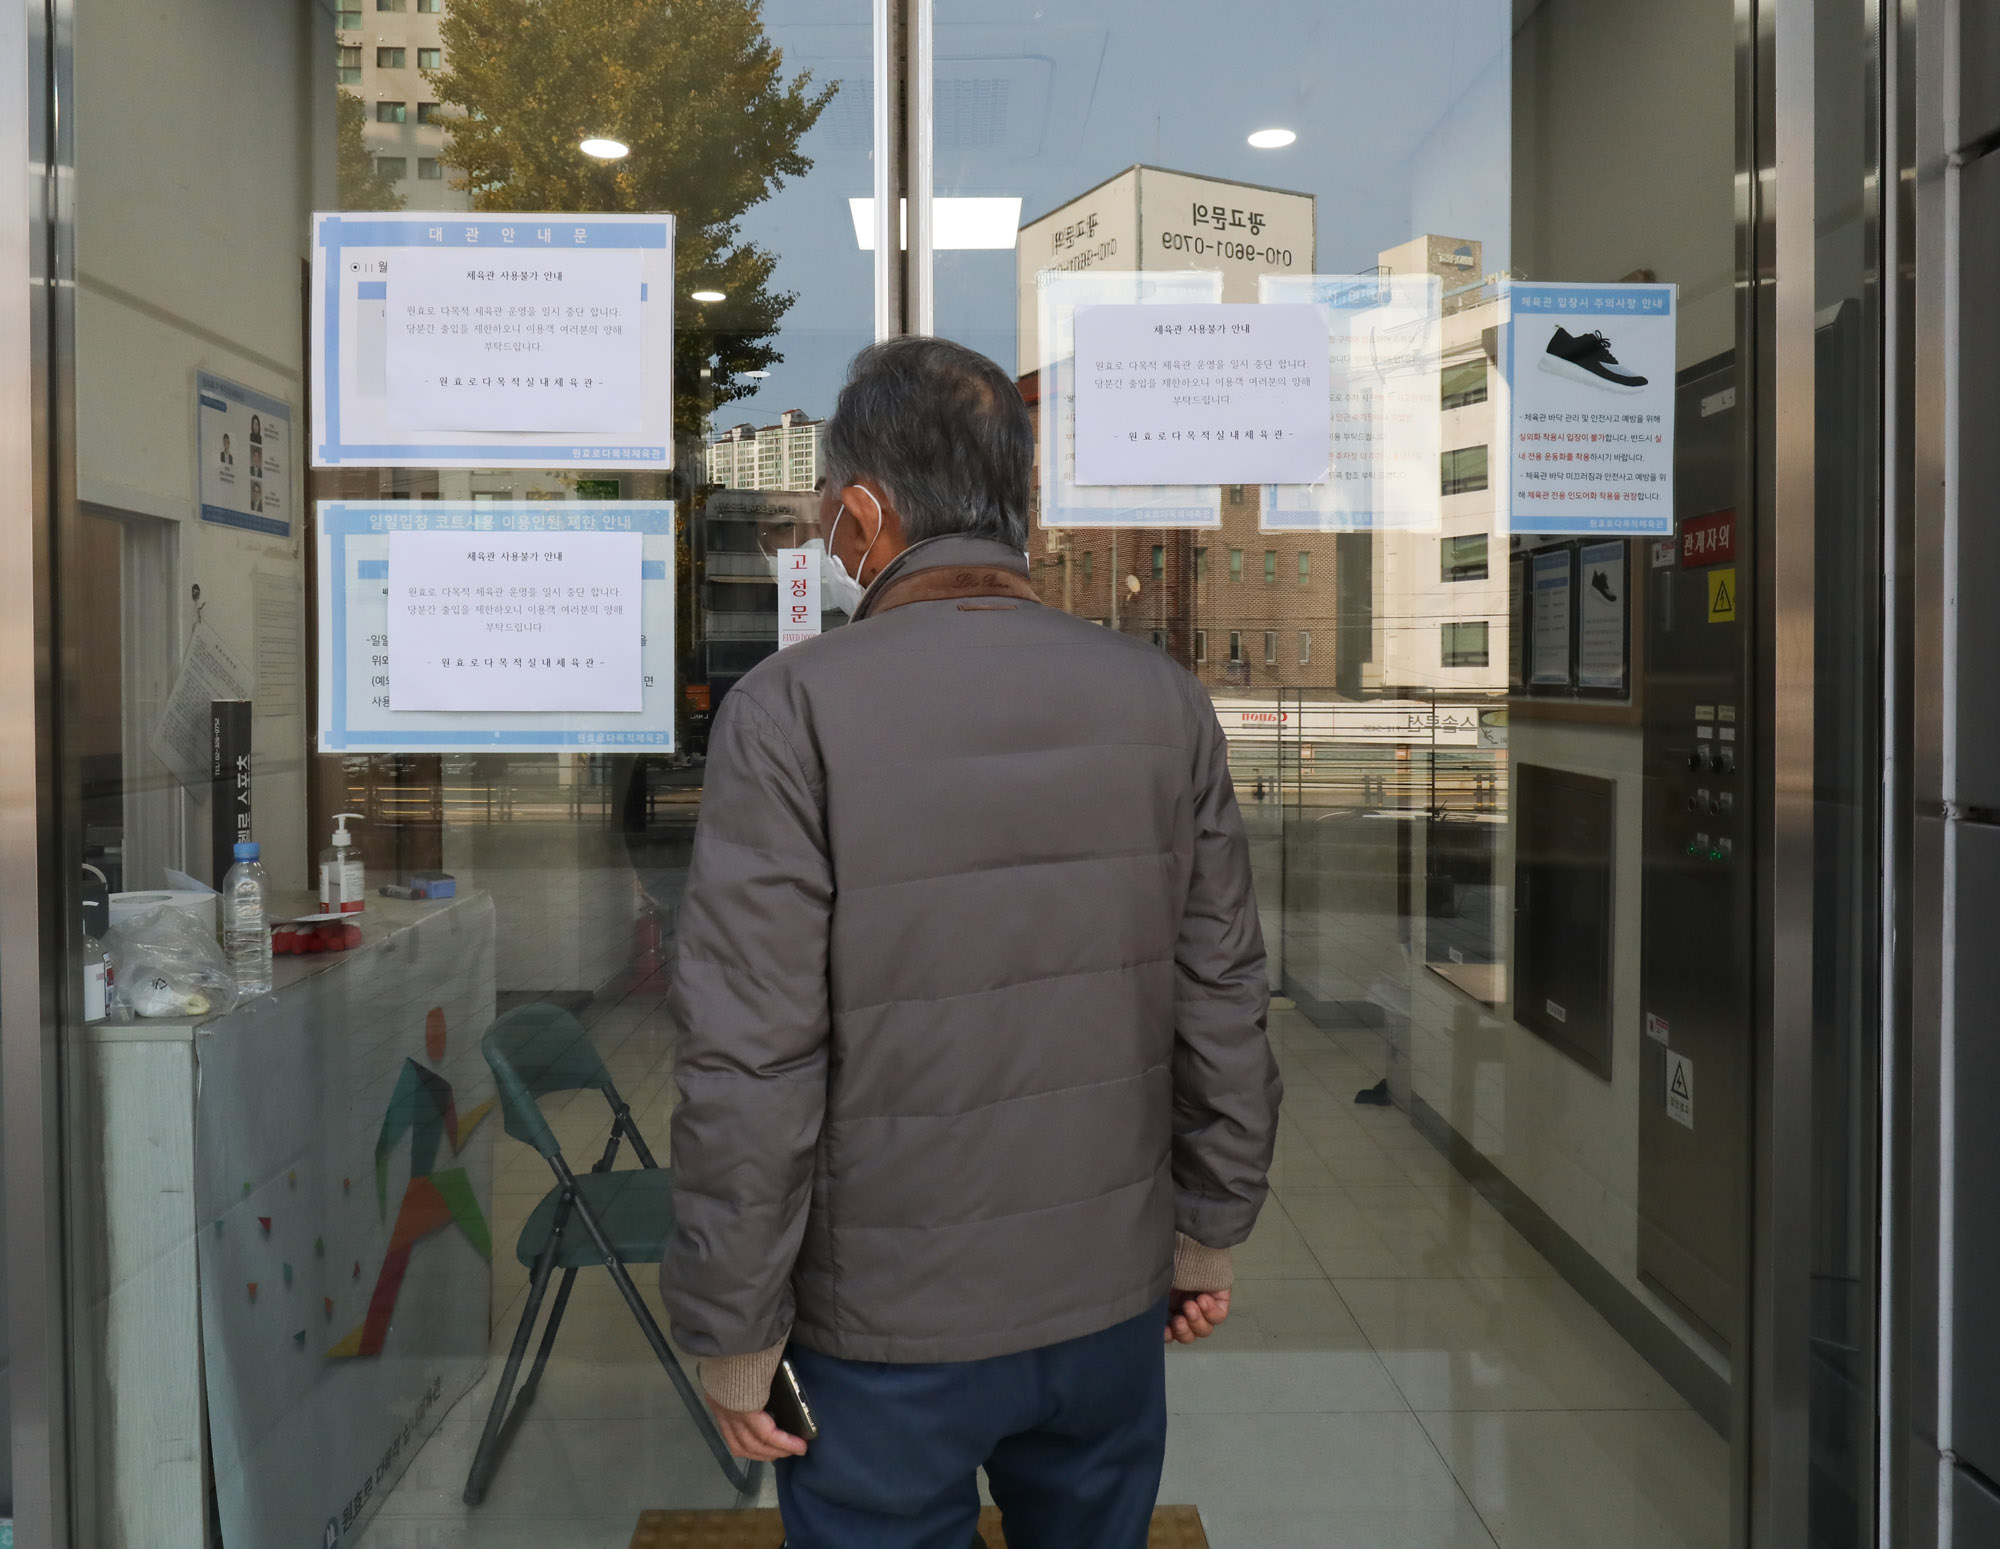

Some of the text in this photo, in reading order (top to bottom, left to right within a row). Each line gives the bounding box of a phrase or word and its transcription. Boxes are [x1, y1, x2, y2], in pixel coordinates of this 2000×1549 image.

[466, 270, 563, 281] 체육관 사용불가 안내
[1520, 297, 1662, 309] 체육관 입장시 주의사항 안내
[406, 306, 622, 318] 원효로 다목적 체육관 운영을 일시 중단 합니다.
[406, 324, 622, 335] 당분간 출입을 제한하오니 이용객 여러분의 양해
[1154, 324, 1250, 335] 체육관 사용불가 안내
[484, 341, 544, 352] 부탁드립니다.
[1095, 360, 1310, 371] 원효로 다목적 체육관 운영을 일시 중단 합니다.
[1094, 377, 1310, 388] 당분간 출입을 제한하오니 이용객 여러분의 양해
[1173, 395, 1233, 406] 부탁드립니다.
[1524, 414, 1660, 424] 체육관 바닥 관리 및 안전사고 예방을 위해
[1519, 433, 1662, 442] 실외화 착용시 입장이 불가합니다. 반드시 실
[1518, 452, 1644, 462] 내 전용 운동화를 착용하시기 바랍니다.
[1525, 472, 1666, 481] 체육관 바닥 미끄러짐과 안전사고 예방을 위
[1518, 492, 1661, 500] 해 체육관 전용 인도어화 착용을 권장합니다.
[1684, 524, 1730, 557] 관계자외
[466, 552, 564, 562] 체육관 사용불가 안내
[408, 586, 622, 598] 원효로 다목적 체육관 운영을 일시 중단 합니다.
[408, 604, 622, 616] 당분간 출입을 제한하오니 이용객 여러분의 양해
[486, 622, 544, 633] 부탁드립니다.
[782, 634, 800, 642] FIXED
[236, 754, 250, 806] 스포츠
